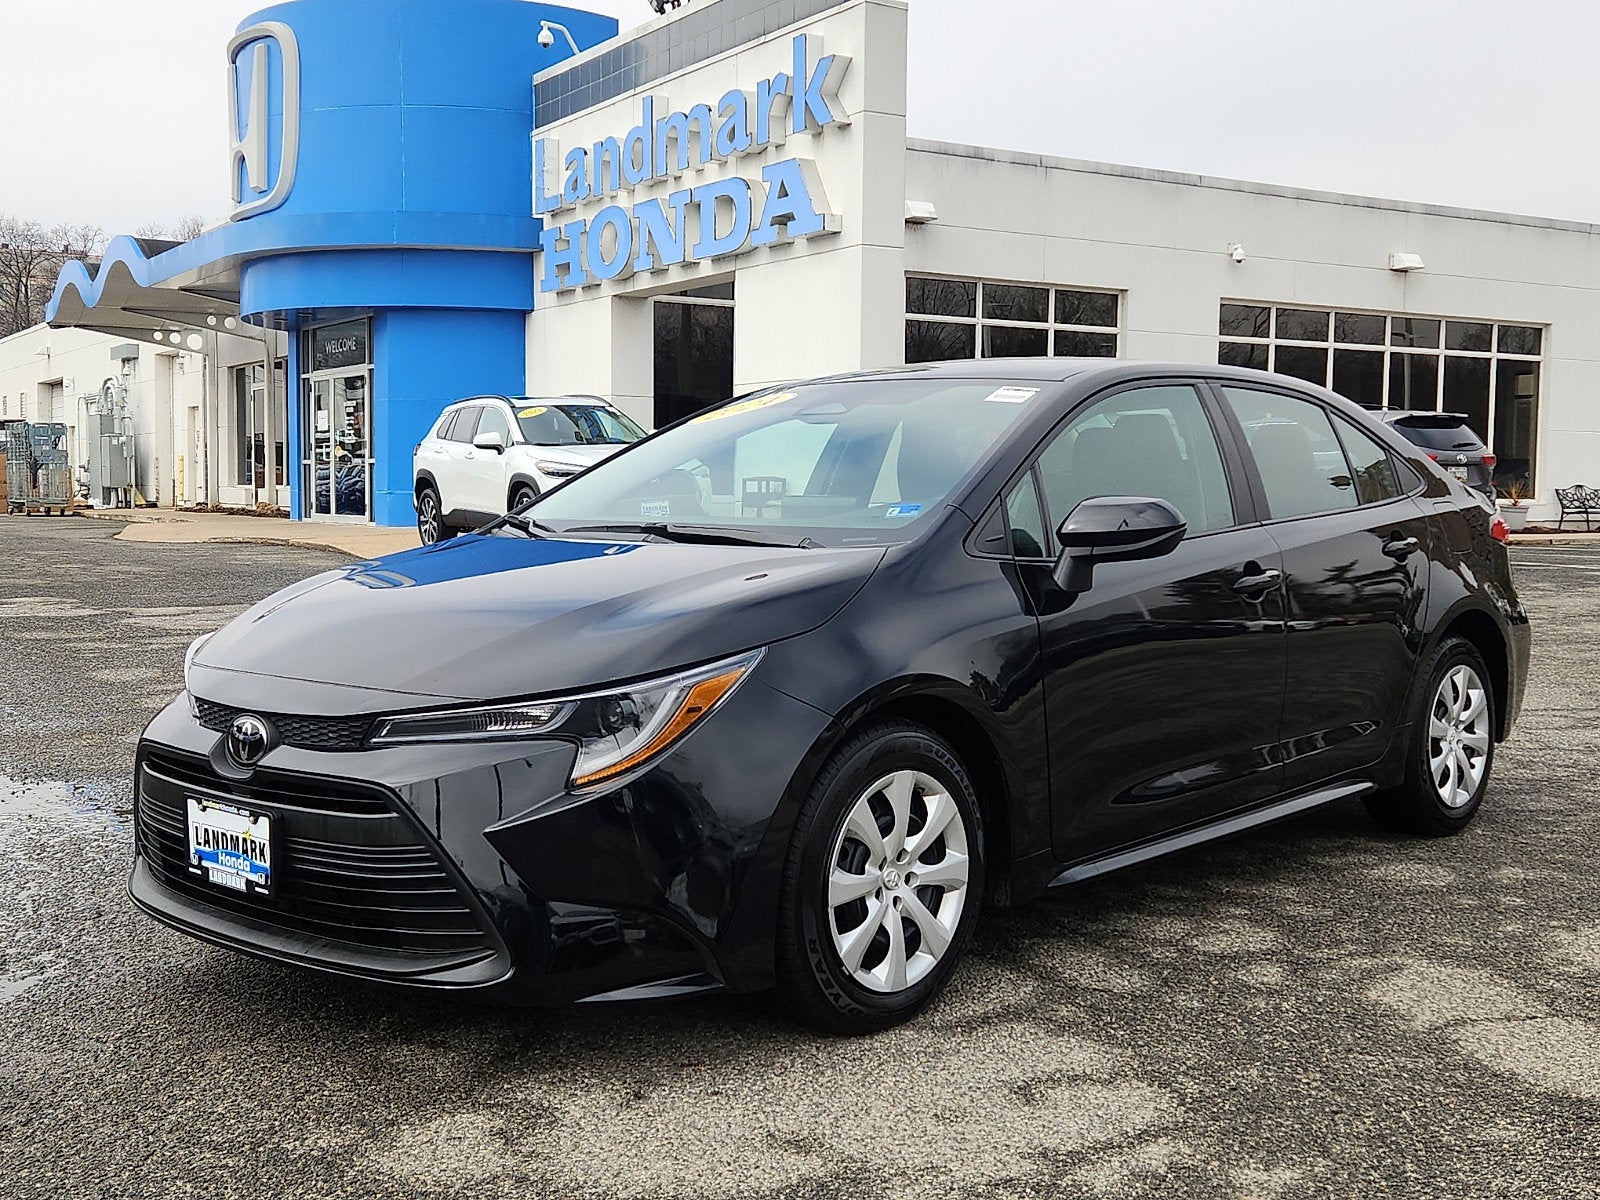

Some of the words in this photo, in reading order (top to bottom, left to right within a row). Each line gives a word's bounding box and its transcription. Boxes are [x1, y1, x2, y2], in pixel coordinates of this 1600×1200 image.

[534, 33, 838, 215] Landmark
[540, 157, 827, 293] HONDA
[325, 336, 357, 354] WELCOME
[194, 824, 268, 865] LANDMARK
[218, 851, 251, 873] Honda
